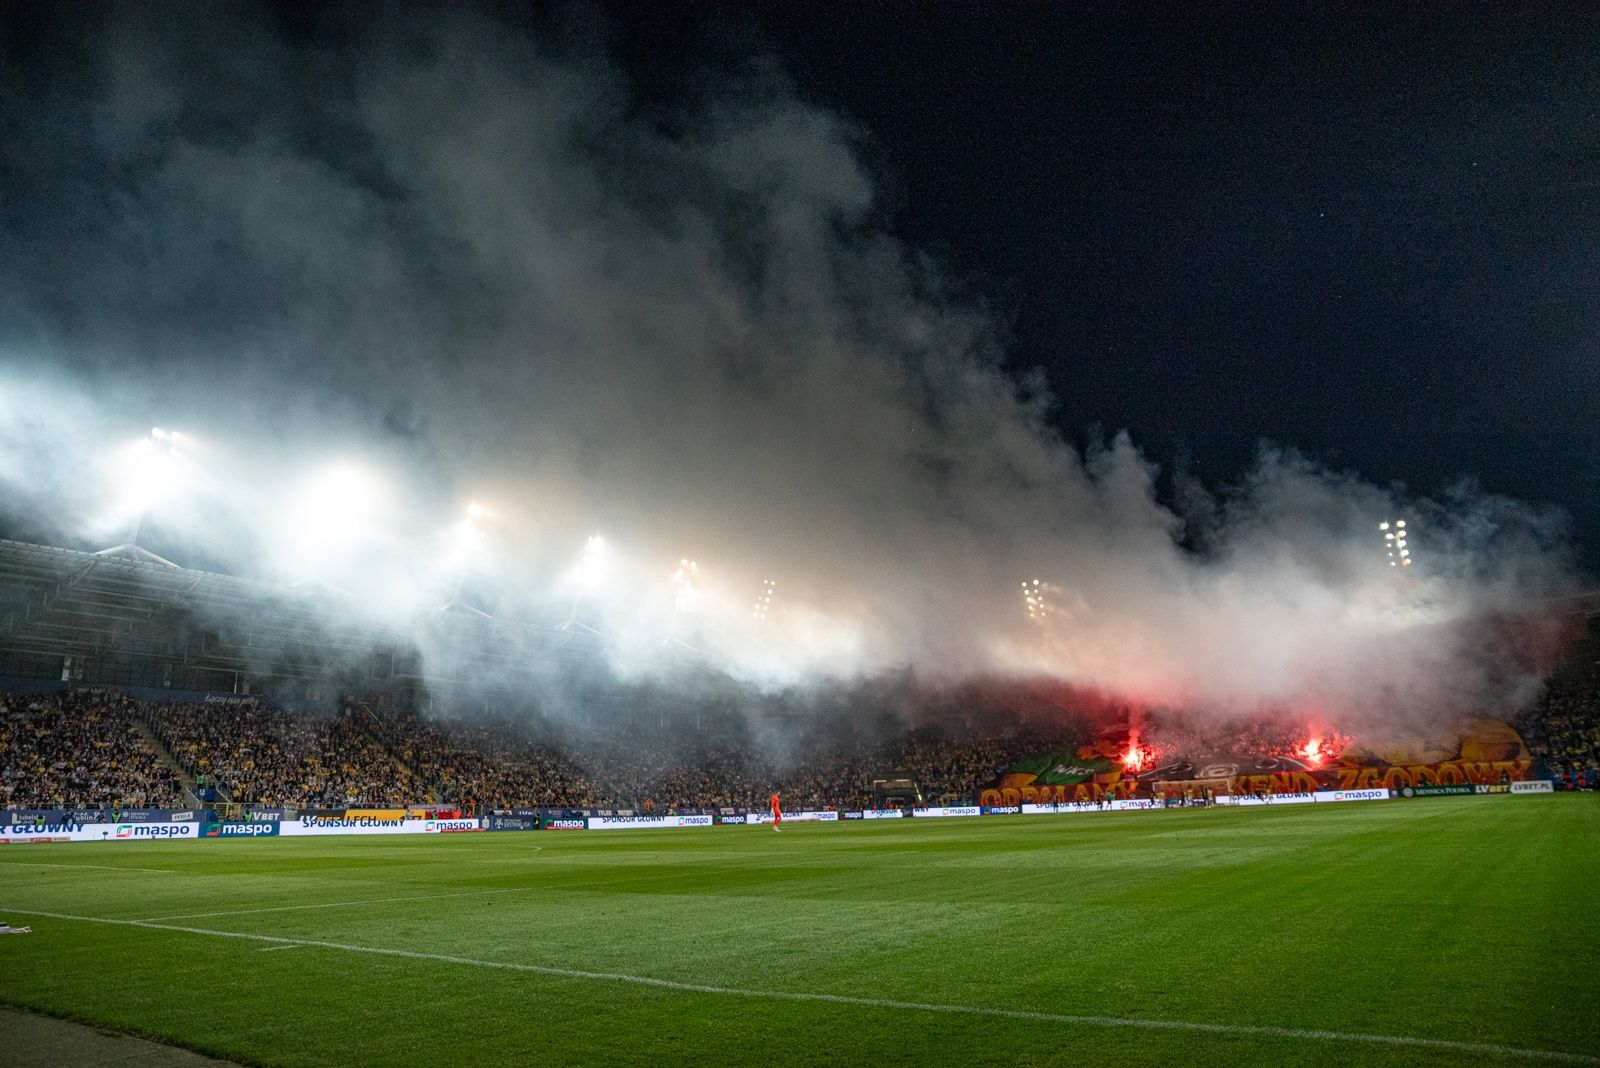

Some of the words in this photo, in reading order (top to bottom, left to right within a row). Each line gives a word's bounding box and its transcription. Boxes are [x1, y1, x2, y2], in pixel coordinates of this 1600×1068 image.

[1344, 791, 1383, 800] maspo
[991, 806, 1020, 814] maspo
[553, 819, 584, 827] maspo
[722, 816, 744, 824] maspo
[134, 825, 190, 837] maspo
[222, 823, 273, 836] maspo
